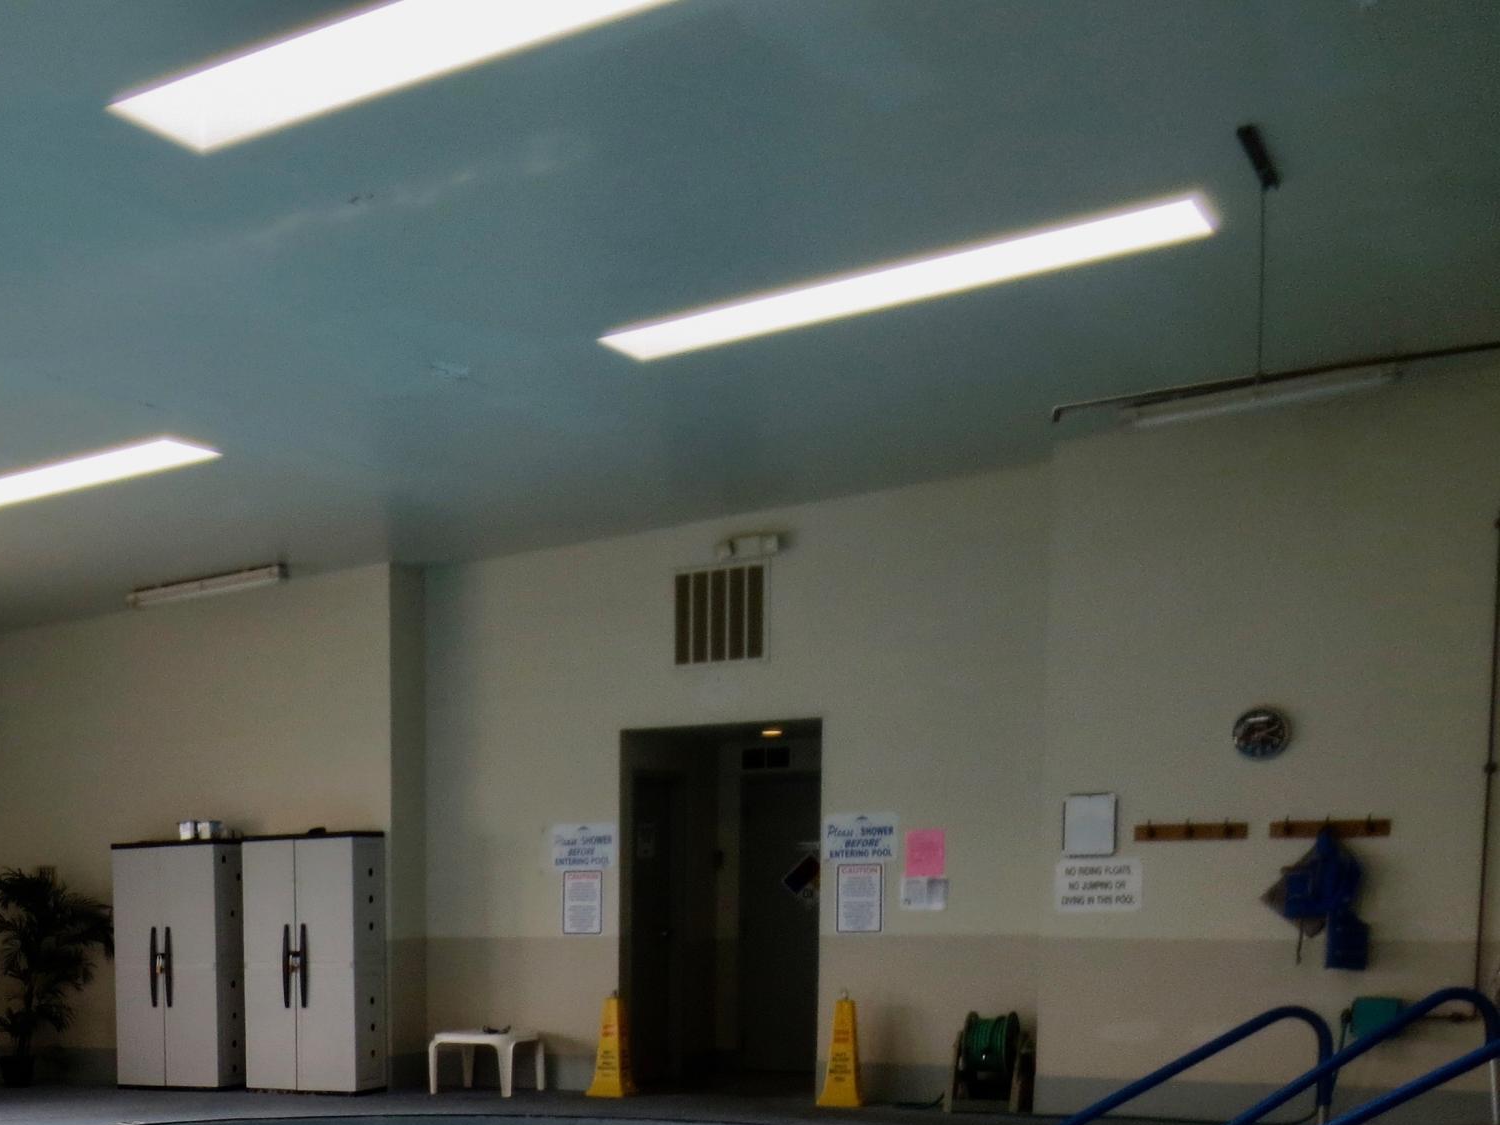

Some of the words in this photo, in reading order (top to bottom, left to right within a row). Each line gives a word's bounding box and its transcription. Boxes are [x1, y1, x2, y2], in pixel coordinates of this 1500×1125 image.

[860, 826, 894, 836] SHOWER
[844, 838, 881, 848] BEFORE
[829, 849, 869, 858] ENTERING
[871, 847, 893, 857] POOL
[1064, 866, 1076, 876] NO
[1068, 881, 1079, 890] NO
[1115, 895, 1135, 904] POOL
